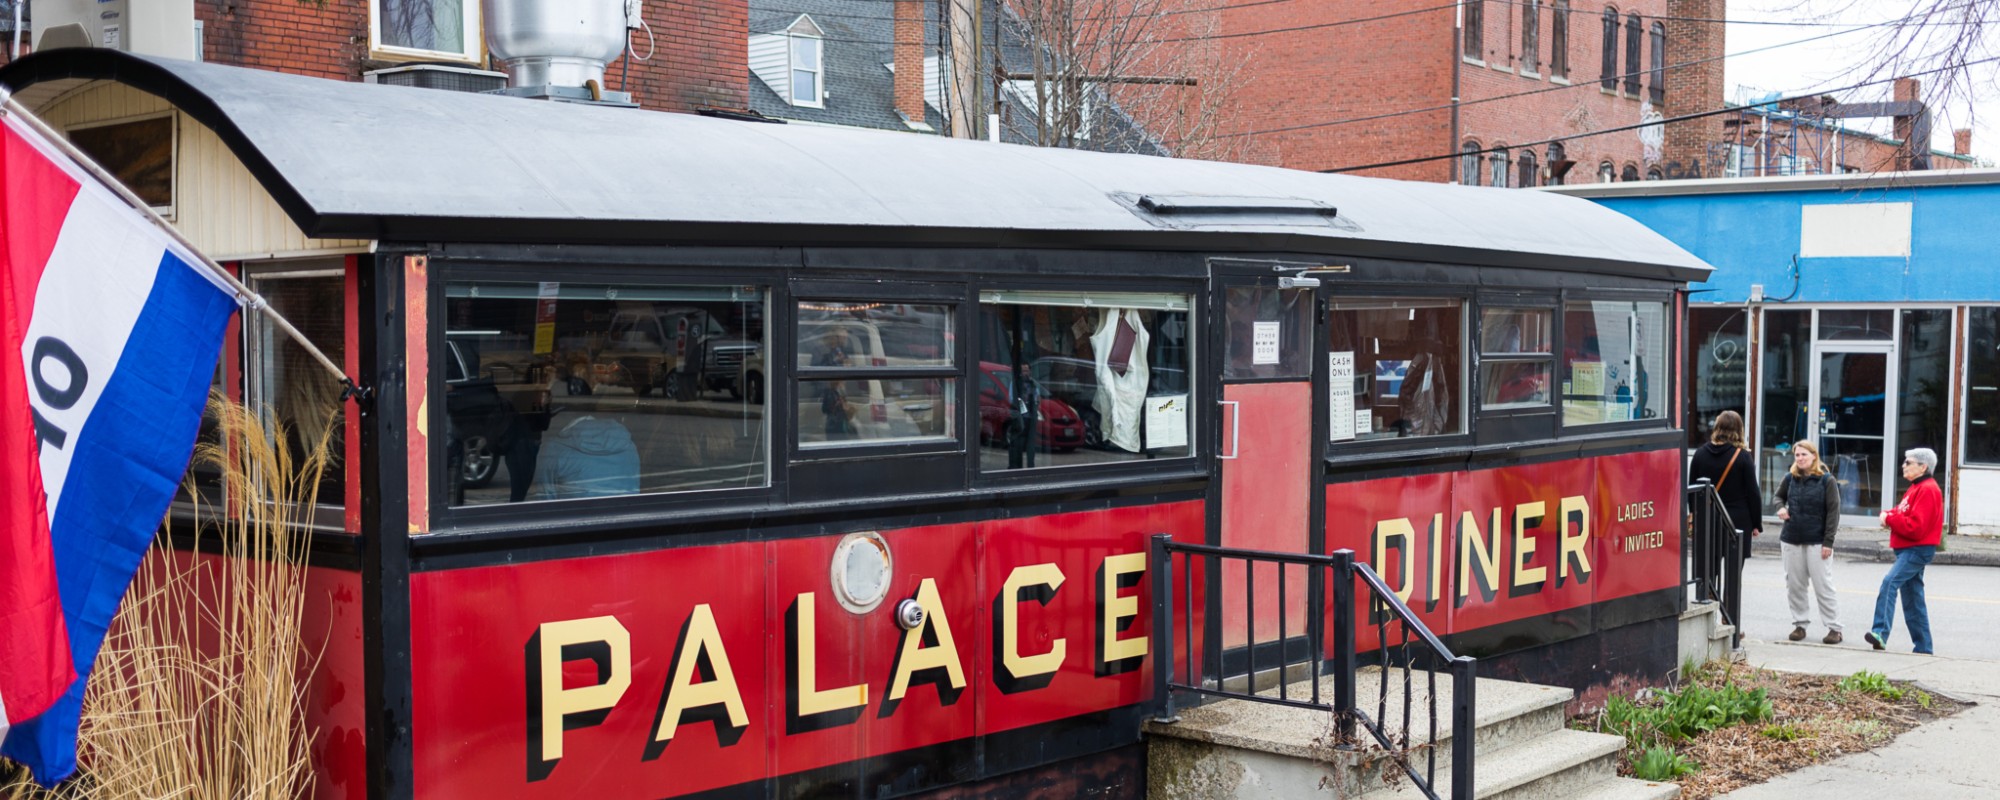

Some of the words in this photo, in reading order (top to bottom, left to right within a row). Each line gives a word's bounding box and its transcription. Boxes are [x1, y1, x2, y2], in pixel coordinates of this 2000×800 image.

[1332, 357, 1351, 366] CASH
[1332, 368, 1351, 377] ONLY
[1617, 500, 1655, 523] LADIES
[1625, 530, 1664, 554] INVITED
[538, 552, 1149, 764] PALACE
[1374, 495, 1592, 613] DINER
